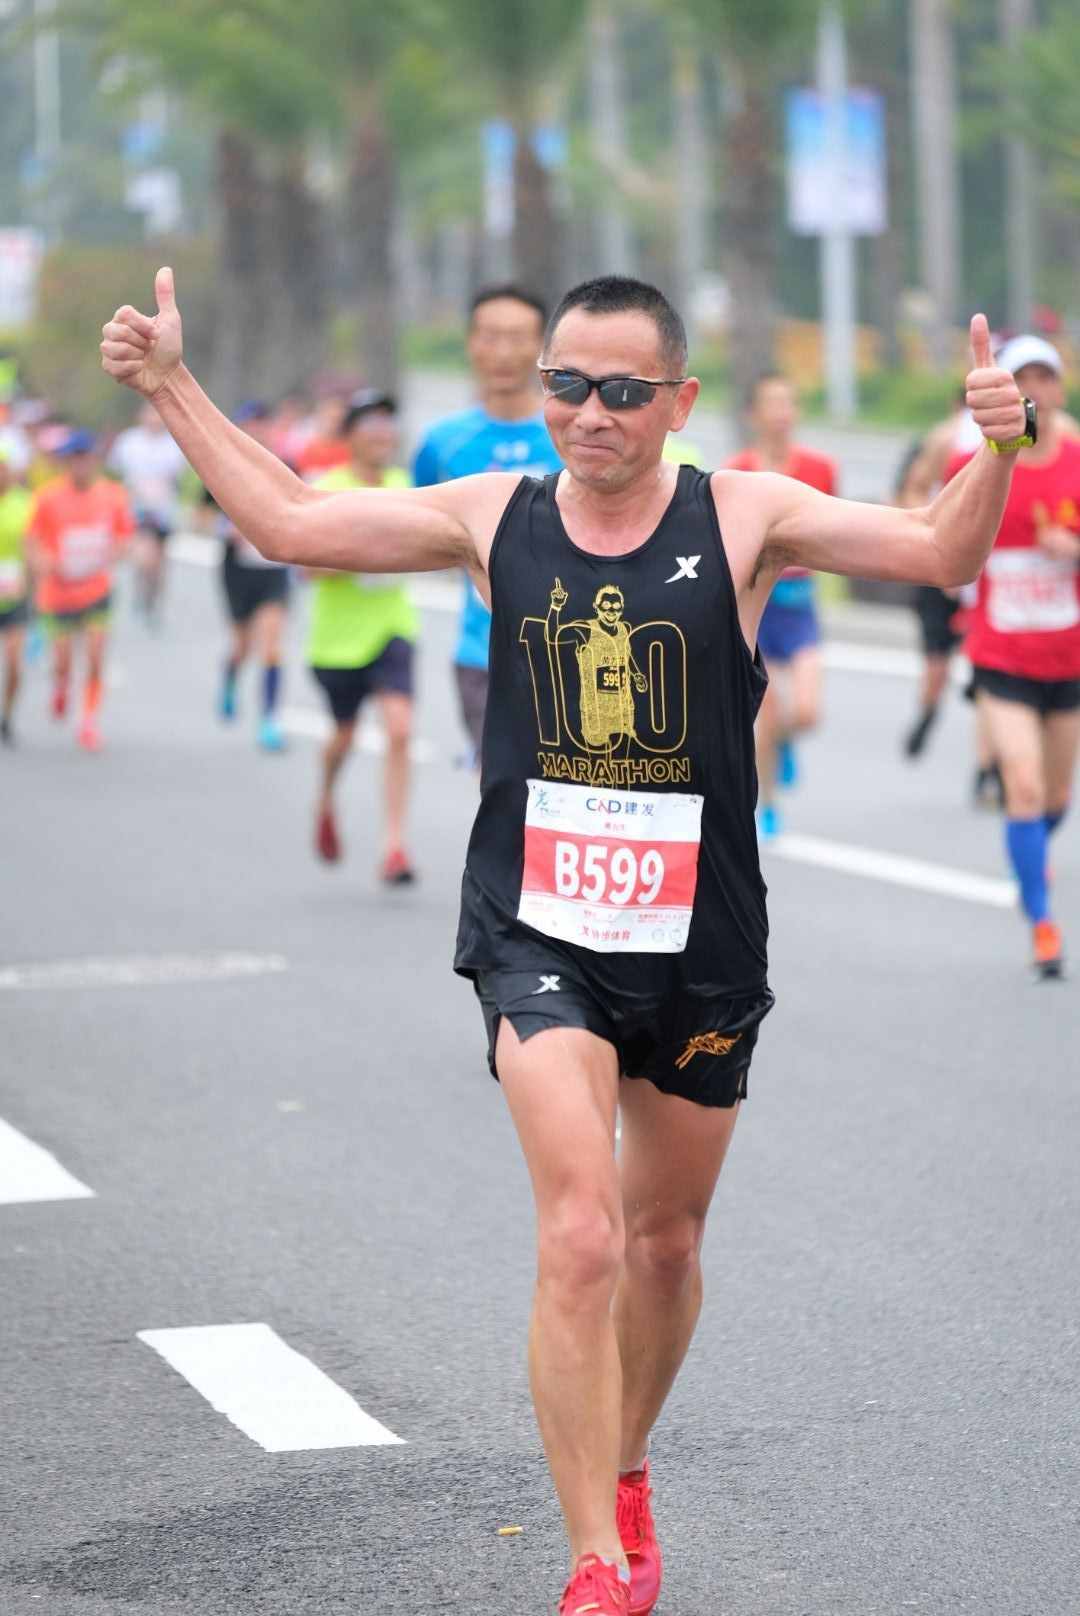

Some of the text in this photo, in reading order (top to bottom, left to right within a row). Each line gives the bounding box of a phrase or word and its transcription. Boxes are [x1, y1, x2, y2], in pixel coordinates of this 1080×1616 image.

[519, 617, 687, 753] 100
[539, 752, 691, 783] MARATHON
[625, 801, 655, 817] 建发
[555, 840, 664, 904] B599
